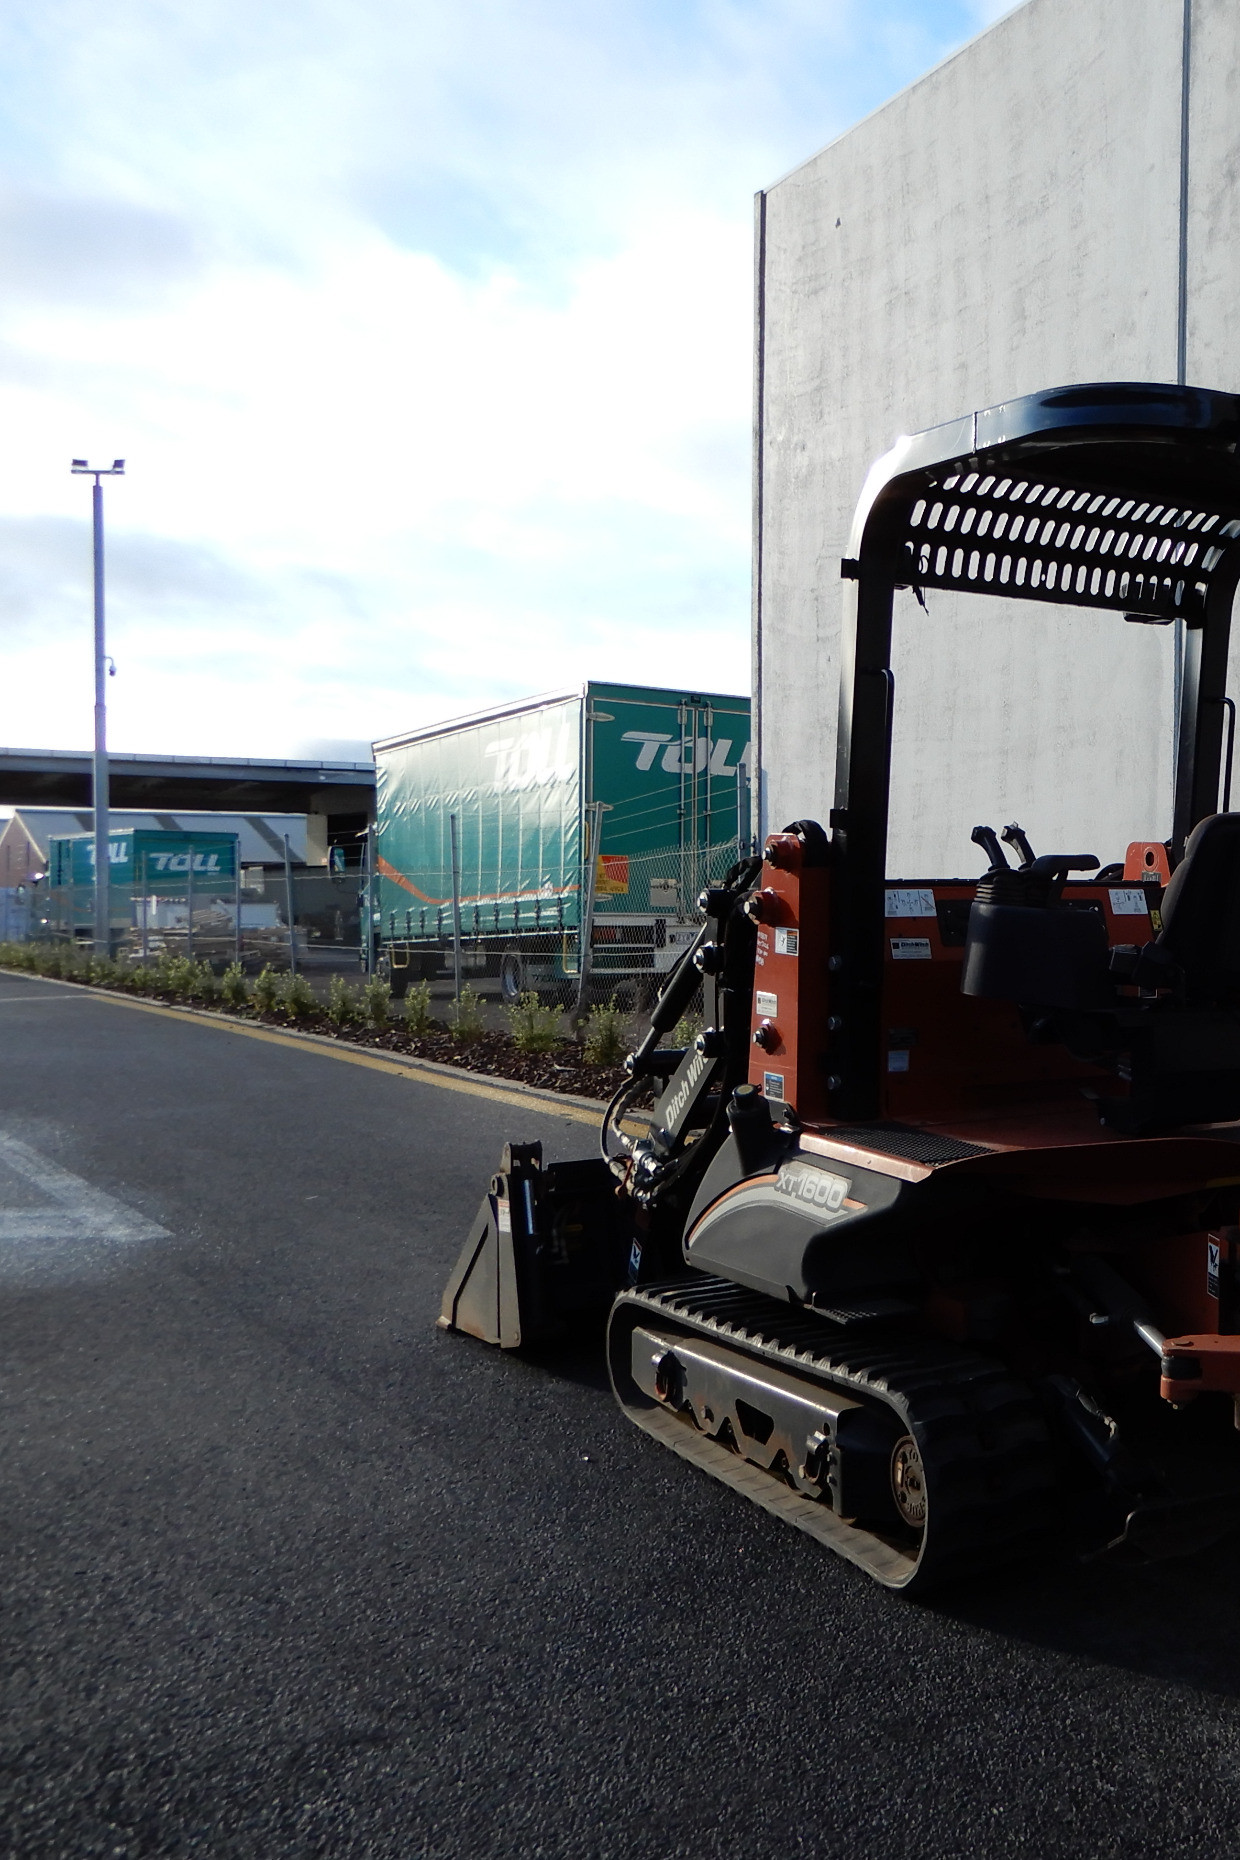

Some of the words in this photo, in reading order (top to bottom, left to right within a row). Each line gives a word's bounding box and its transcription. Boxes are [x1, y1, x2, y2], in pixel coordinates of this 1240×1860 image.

[484, 721, 574, 794] TOLL
[87, 842, 128, 865] TLL
[149, 852, 222, 871] TOLL
[665, 1079, 691, 1131] Ditch
[776, 1171, 847, 1210] XT1600
